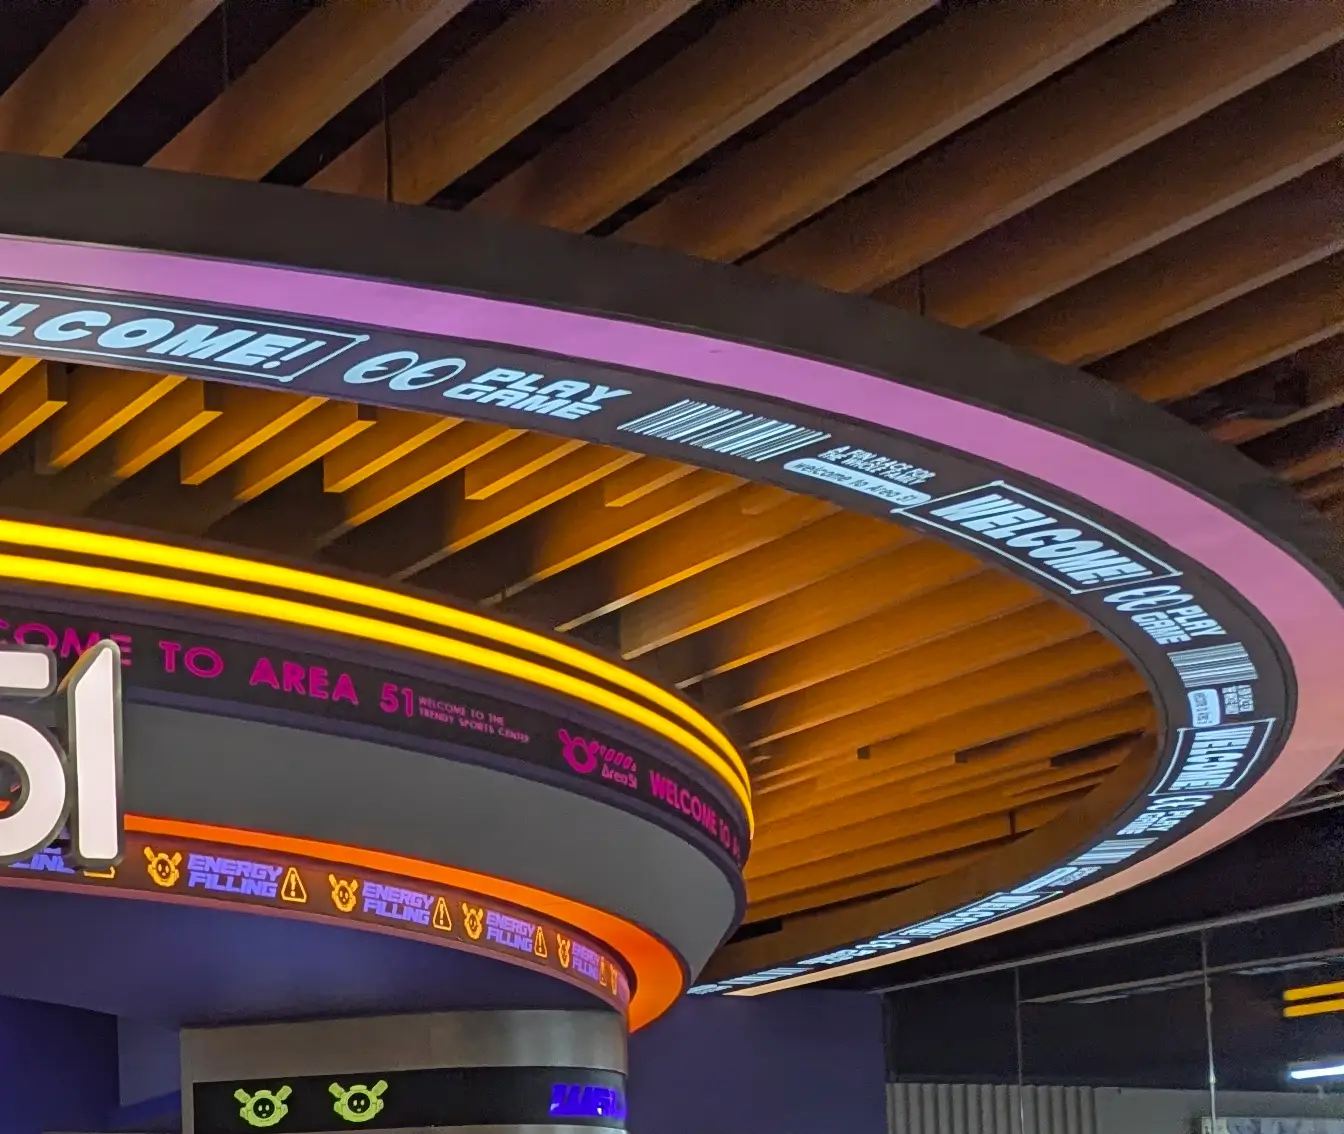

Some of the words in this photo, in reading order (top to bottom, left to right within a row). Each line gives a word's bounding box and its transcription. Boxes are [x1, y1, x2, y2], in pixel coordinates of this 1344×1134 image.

[443, 383, 603, 420] GAME
[470, 368, 632, 403] PLAY
[929, 494, 1154, 585] WELCOME!
[159, 640, 225, 679] TO
[250, 657, 359, 706] AREA
[380, 682, 414, 718] 51
[649, 770, 717, 837] WELCOME
[188, 852, 283, 883] ENERGY
[188, 871, 278, 899] FILLING
[363, 880, 436, 910] ENERGY
[363, 897, 430, 927] FILLING
